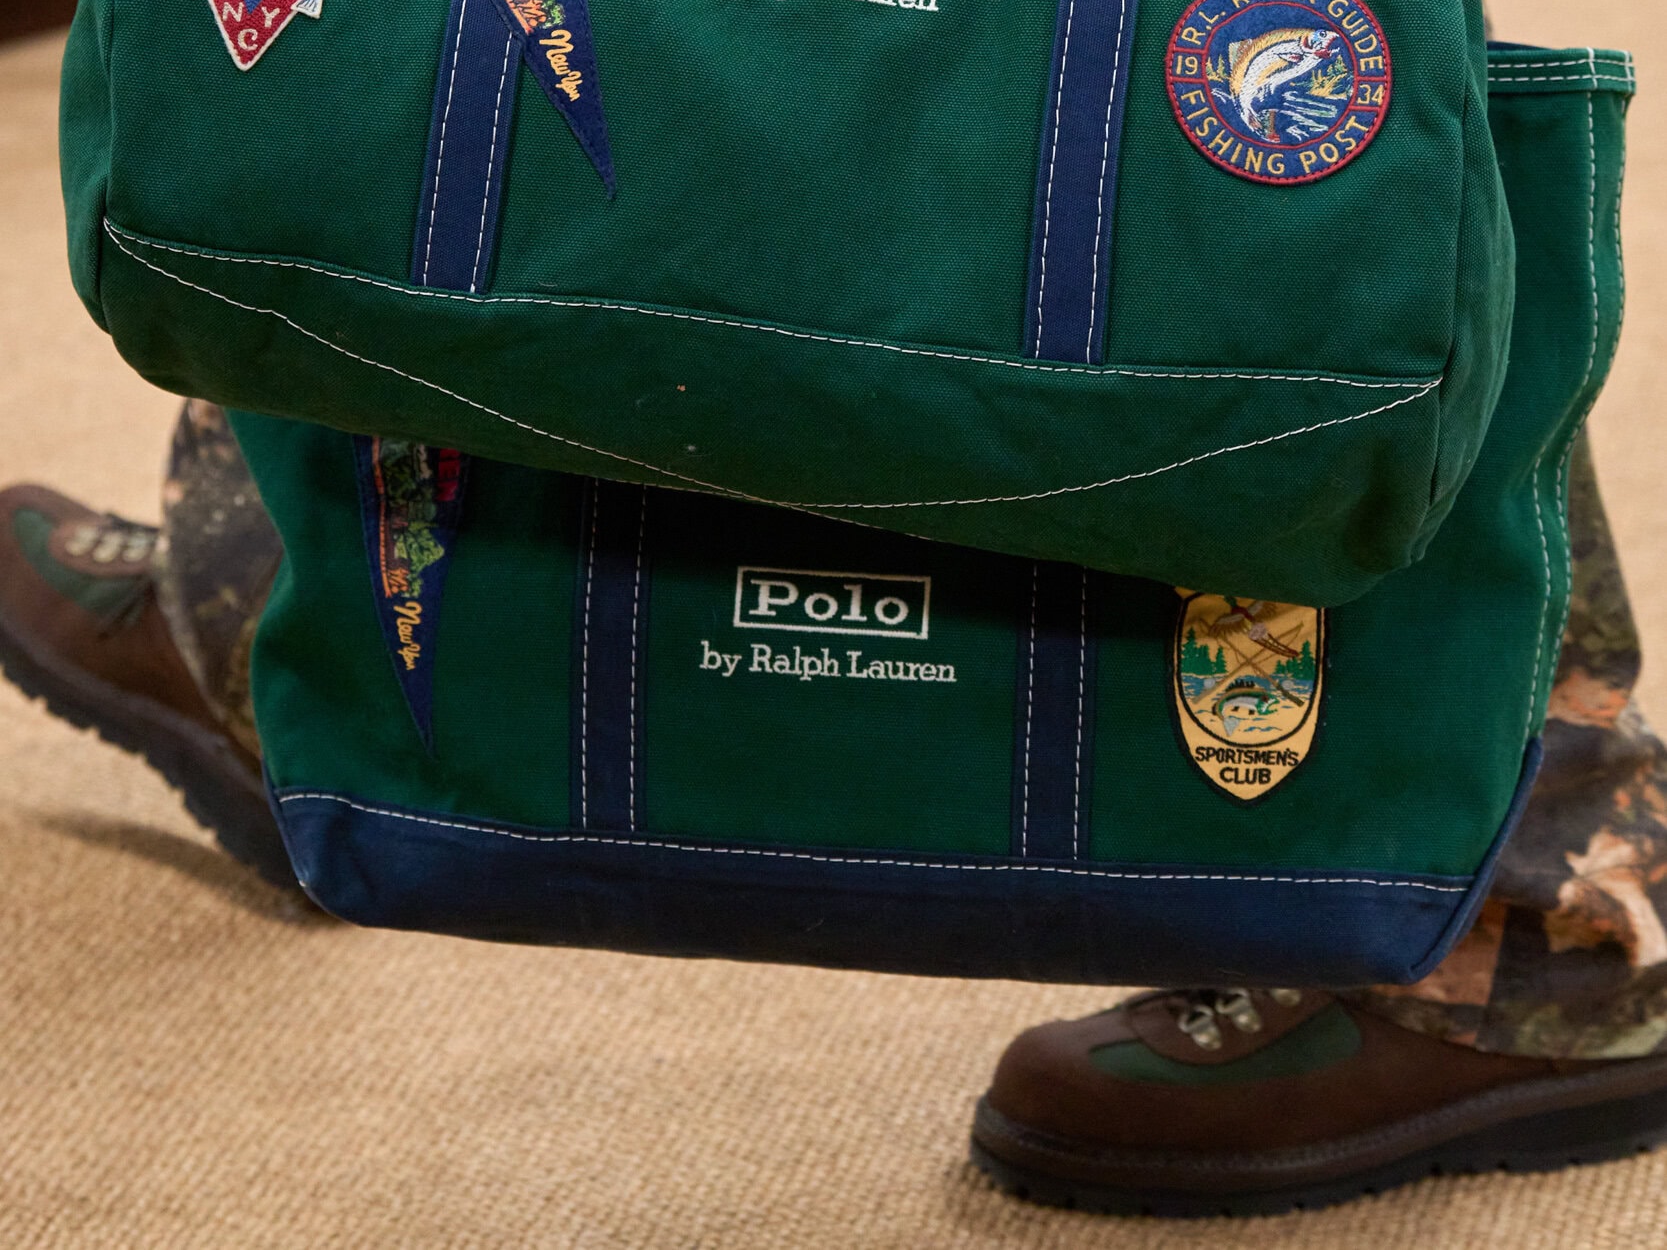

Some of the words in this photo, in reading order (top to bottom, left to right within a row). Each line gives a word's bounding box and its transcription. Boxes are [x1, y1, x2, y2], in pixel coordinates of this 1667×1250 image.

[539, 29, 575, 76] New
[1175, 54, 1199, 76] 19
[1356, 84, 1385, 106] 34
[1180, 88, 1286, 175] FISHING
[1299, 115, 1370, 175] POST
[748, 579, 910, 626] Polo
[699, 639, 742, 678] by
[748, 643, 842, 682] Ralph
[845, 650, 958, 683] Lauren
[1194, 745, 1300, 767] SPORTSMEN'S
[1218, 766, 1272, 785] CLUB
